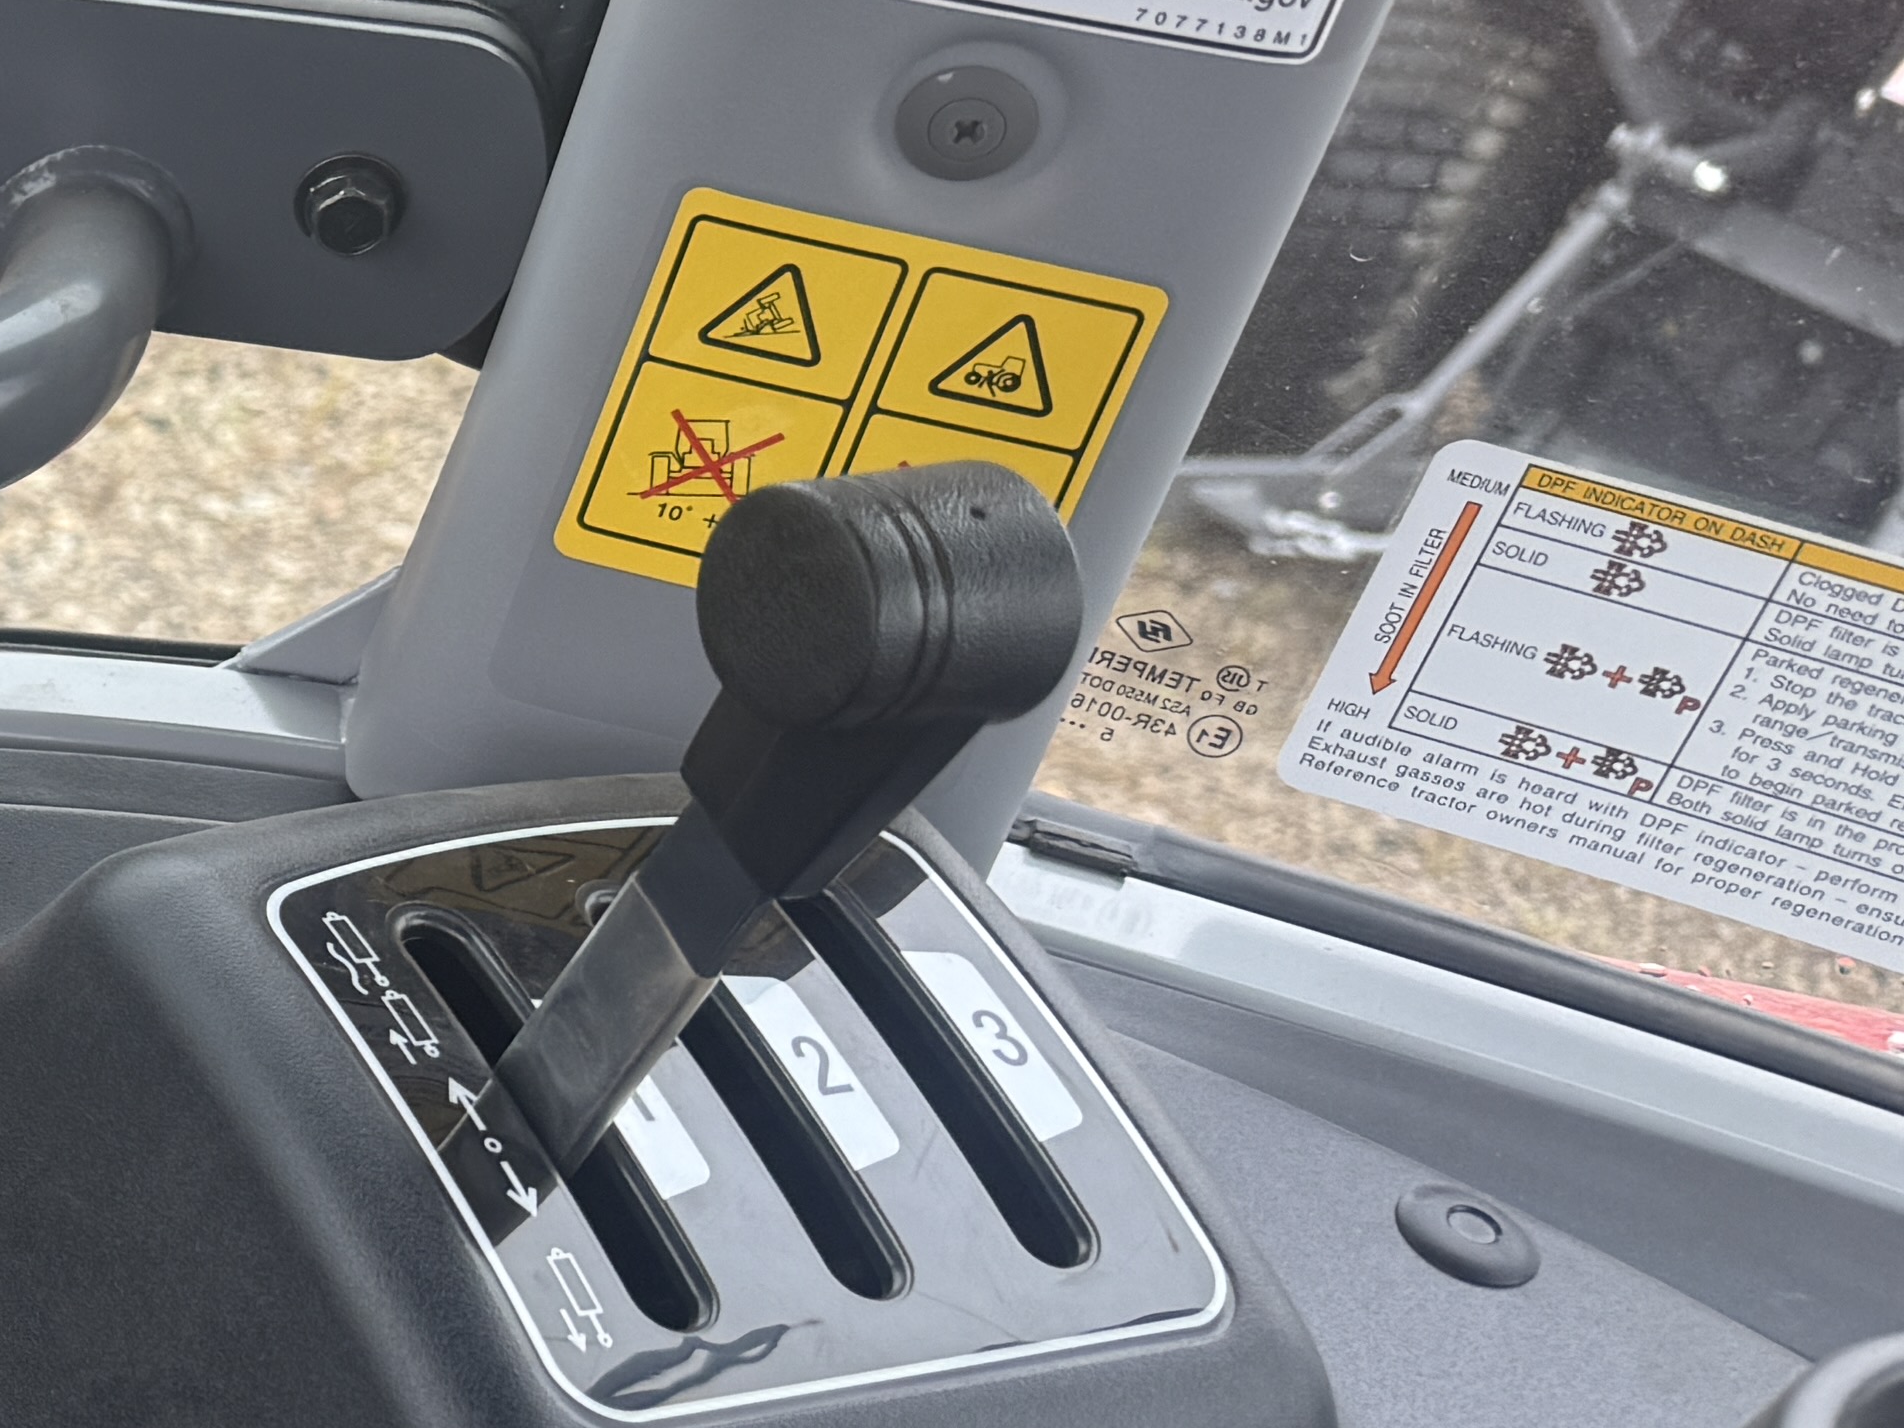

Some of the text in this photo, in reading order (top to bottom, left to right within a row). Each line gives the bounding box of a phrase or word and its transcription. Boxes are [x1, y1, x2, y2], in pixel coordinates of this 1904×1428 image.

[1446, 468, 1511, 497] MEDIUM
[1513, 501, 1607, 539] FLASHING
[1537, 472, 1786, 554] DPF INDICATOR ON DASH
[1492, 541, 1549, 567] SOLID
[1373, 527, 1448, 644] SOOT IN FILTER
[1787, 589, 1816, 609] No
[1825, 603, 1879, 626] need
[1798, 571, 1884, 606] Clogged
[1447, 623, 1538, 661] FLASHING
[1764, 627, 1816, 652] Solid
[1823, 644, 1873, 671] lamp
[1774, 609, 1900, 657] DPF filter is
[1751, 648, 1825, 680] Parked
[1326, 697, 1371, 720] HIGH
[1404, 704, 1459, 731] SOLID
[1770, 674, 1817, 700] Stop
[1826, 691, 1858, 711] the
[1758, 693, 1817, 722] Apply
[1822, 715, 1899, 748] parking
[1708, 719, 1900, 787] 3. Press and Hold
[1731, 745, 1760, 765] for
[1766, 757, 1783, 772] 3
[1789, 766, 1875, 802] seconds.
[1307, 735, 1388, 770] Exhaust
[1395, 763, 1466, 793] gasses
[1476, 787, 1510, 805] are
[1519, 797, 1554, 819] hot
[1562, 810, 1627, 843] during
[1636, 831, 1685, 857] filter
[1693, 850, 1826, 902] regeneration
[1316, 718, 1333, 732] If
[1339, 724, 1412, 757] audible
[1422, 751, 1479, 777] alarm
[1490, 768, 1508, 784] is
[1517, 776, 1579, 806] heard
[1588, 796, 1630, 821] with
[1639, 813, 1688, 836] DPF
[1695, 829, 1789, 868] indicator
[1813, 869, 1899, 904] perform
[1676, 773, 1721, 797] DPF
[1729, 791, 1774, 815] filter
[1782, 807, 1799, 823] is
[1806, 815, 1826, 833] in
[1833, 824, 1866, 844] the
[1721, 763, 1740, 780] to
[1749, 772, 1804, 800] begin
[1811, 793, 1883, 823] parked
[1299, 752, 1399, 792] Reference
[1411, 784, 1478, 815] tractor
[1486, 808, 1559, 840] owners
[1567, 834, 1647, 867] manual
[1653, 858, 1685, 877] for
[1692, 871, 1763, 902] proper
[1666, 791, 1713, 815] Both
[1720, 808, 1768, 834] solid
[1774, 824, 1824, 850] lamp
[1832, 841, 1882, 870] turns
[970, 1008, 1030, 1067] 3
[790, 1034, 855, 1097] 2
